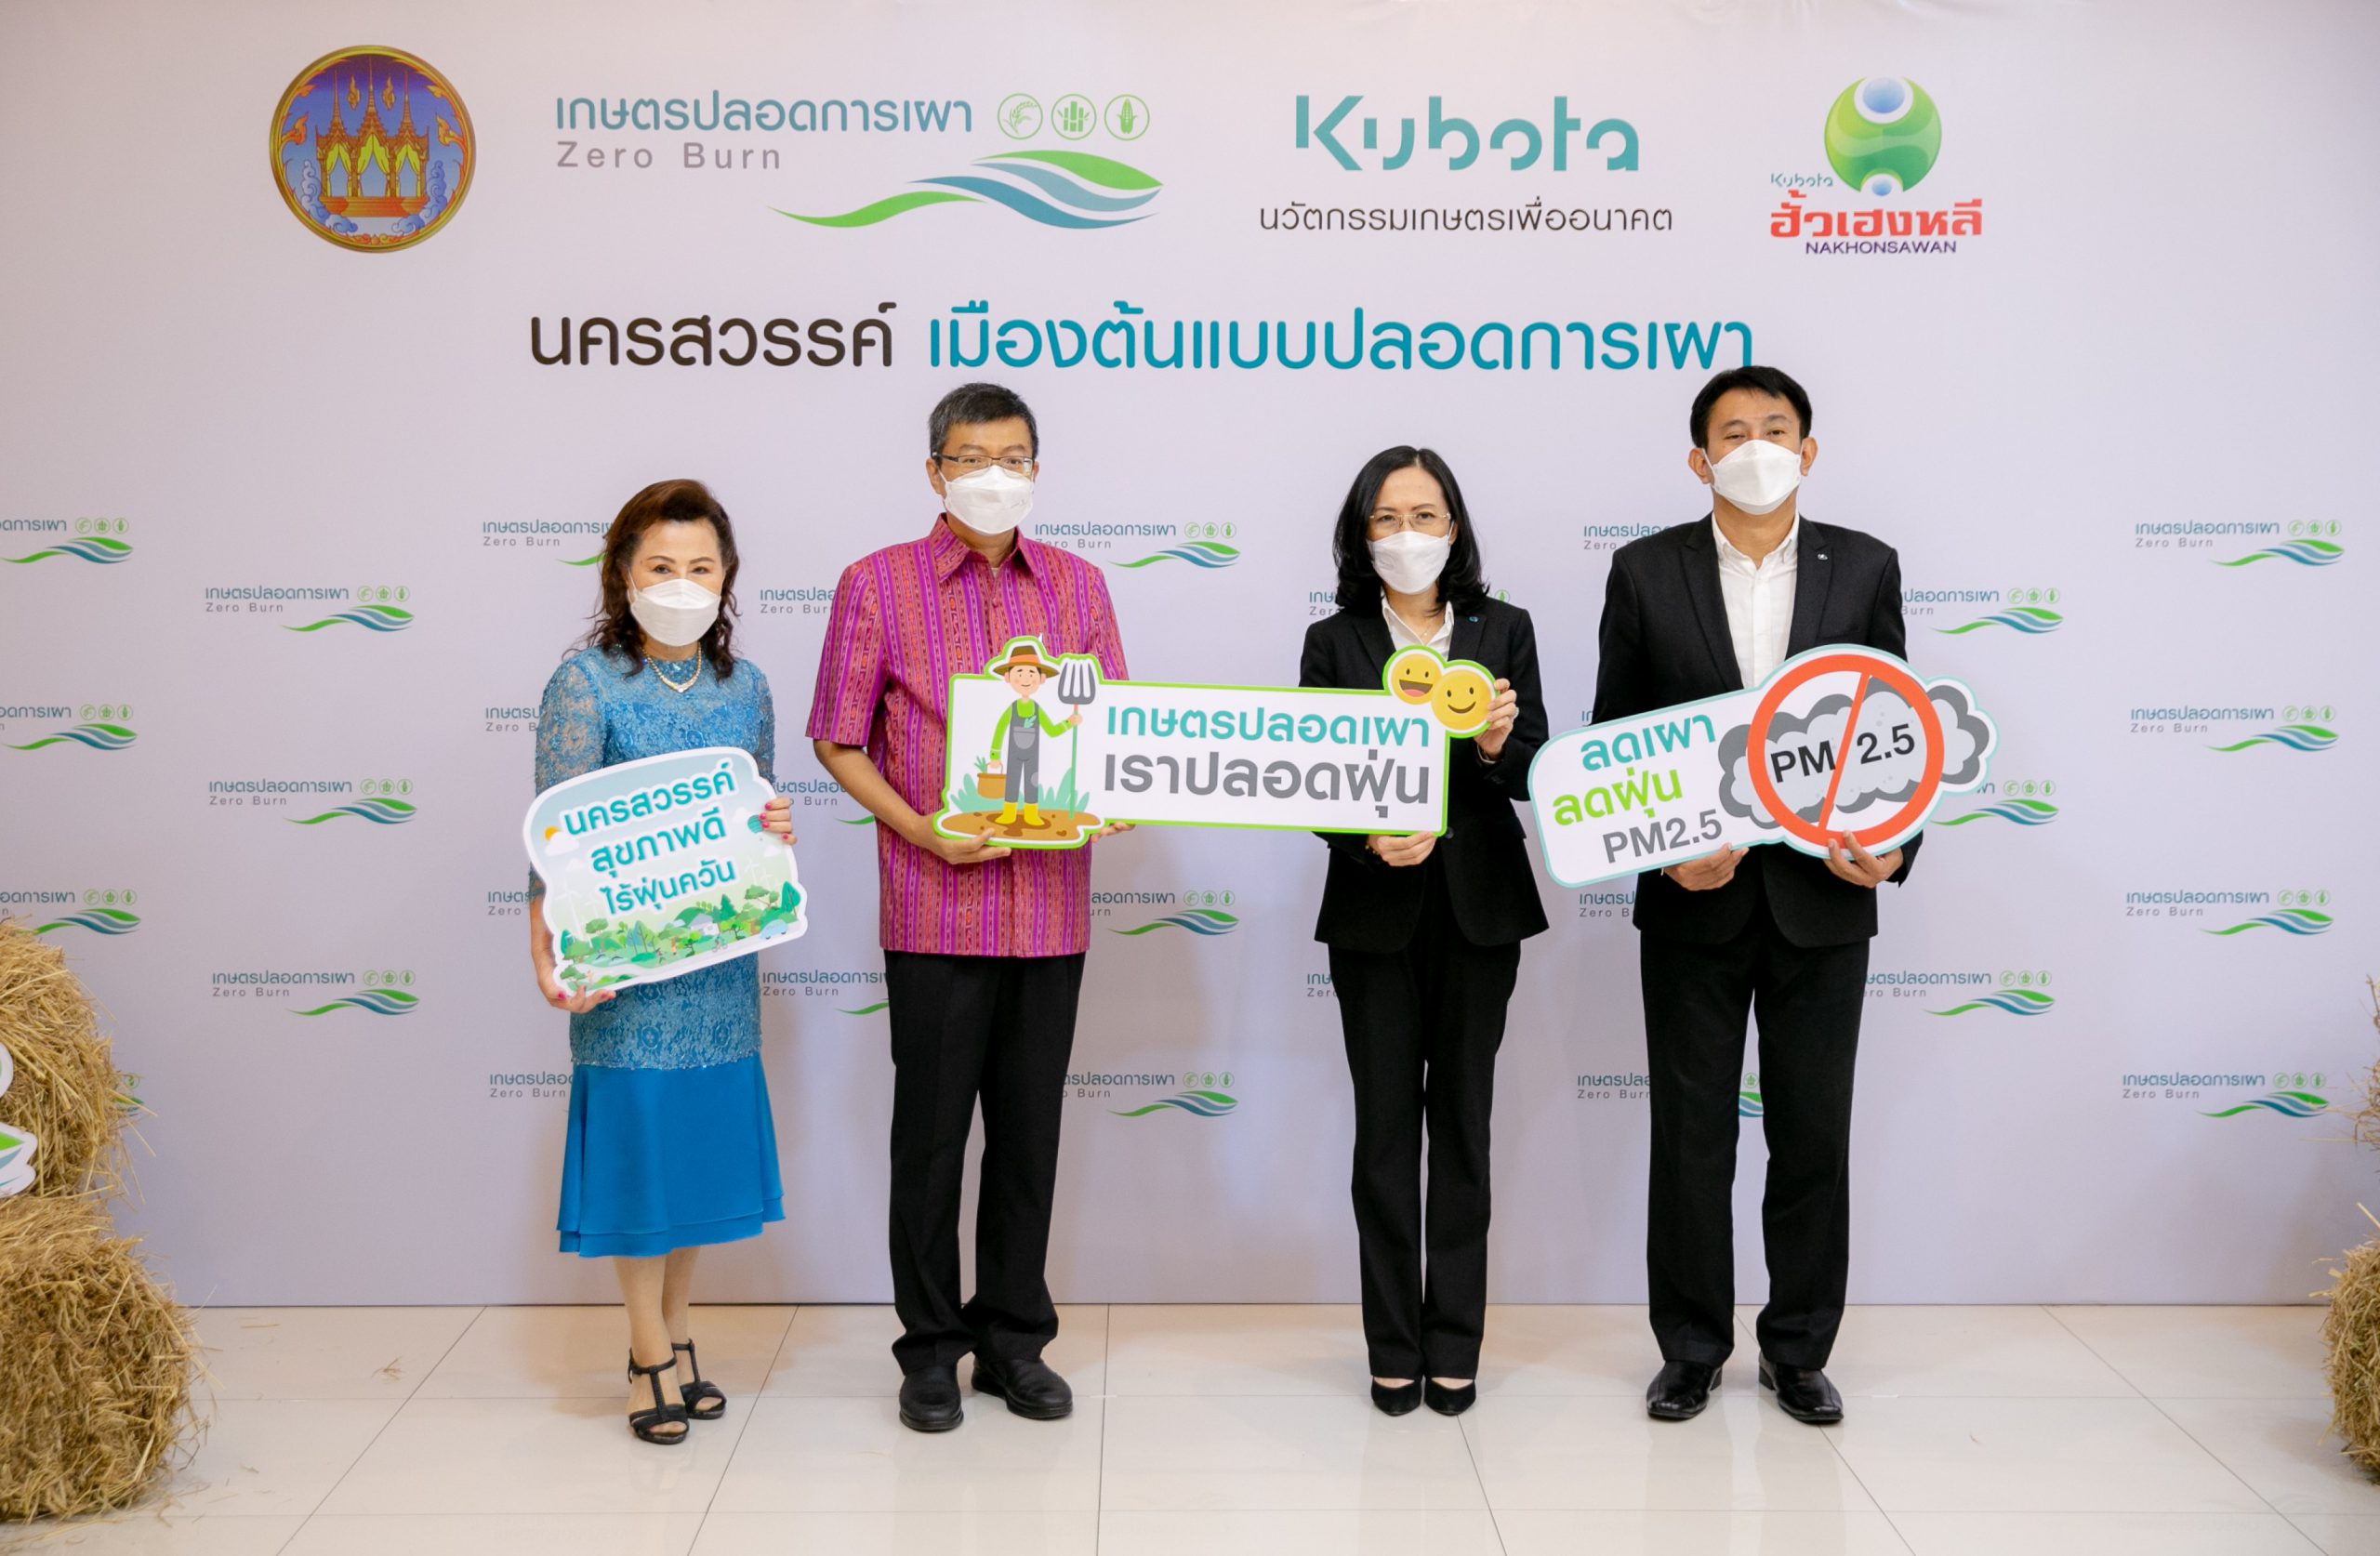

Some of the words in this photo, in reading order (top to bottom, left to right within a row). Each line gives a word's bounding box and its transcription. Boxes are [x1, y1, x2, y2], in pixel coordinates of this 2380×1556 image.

[557, 89, 972, 132] เกษตรปลอดการเผา
[557, 141, 654, 169] Zero
[684, 141, 780, 169] Burn
[1260, 198, 1673, 232] นวัตกรรมเกษตรเพื่ออนาคต
[1770, 189, 1982, 238] ฮั้วเฮงหลี
[1805, 241, 1957, 255] NAKHONSAWAN
[531, 301, 898, 367] นครสวรรค์
[931, 298, 1753, 370] เมืองต้นแบบปลอดการเผา
[483, 520, 613, 534] เกษตรปลอดการเ
[1035, 521, 1177, 535] เกษตรปลอดการเผา
[2135, 521, 2281, 534] เกษตรปลอดการเผา
[483, 536, 517, 547] Zero
[526, 536, 560, 547] Burn
[1078, 539, 1111, 548] Burn
[1584, 540, 1617, 550] Zero
[2135, 538, 2169, 548] Zero
[2179, 538, 2213, 548] Burn
[205, 586, 349, 600] เกษตรปลอดการเผา
[1904, 588, 2000, 602] ปลอดการเผา
[205, 602, 239, 613] Zero
[249, 602, 283, 613] Burn
[760, 604, 793, 614] Zero
[2130, 706, 2275, 720] เกษตรปลอดการเผา
[485, 722, 519, 732] Zero
[1107, 706, 1429, 747] เกษตรปลอดเผา
[2131, 723, 2164, 732] Zero
[2174, 723, 2207, 732] Burn
[1580, 714, 1716, 771] ลดเผา
[1770, 740, 1836, 783] PM
[1857, 723, 1916, 765] 2.5
[209, 779, 351, 793] เกษตรปลอดการเผา
[1104, 749, 1430, 818] เราปลอดฝุ่น
[210, 796, 244, 805] Zero
[253, 796, 286, 805] Burn
[564, 762, 735, 836] นครสวรรค์
[804, 797, 838, 806] Burn
[1553, 767, 1683, 825] ลดฝุ่น
[590, 807, 727, 877] สุขภาพดี
[1602, 809, 1723, 864] PM2.5
[600, 859, 736, 915] ไร้ฝุ่นควัน
[1091, 892, 1176, 904] ลอดการเผา
[2126, 890, 2270, 903] เกษตรปลอดการเผา
[488, 906, 522, 916] Zero
[1579, 908, 1612, 918] Zero
[2127, 906, 2161, 916] Zero
[2169, 906, 2203, 916] Burn
[212, 970, 355, 984] เกษตรปลอดการเผา
[762, 969, 887, 983] เกษตรปลอดการเ
[1866, 970, 1991, 984] ษตรปลอดการเผา
[213, 987, 246, 997] Zero
[256, 987, 289, 997] Burn
[762, 987, 796, 996] Zero
[805, 987, 839, 996] Burn
[1893, 988, 1926, 997] Burn
[2122, 1073, 2266, 1087] เกษตรปลอดการเผา
[490, 1088, 523, 1099] Zero
[533, 1088, 566, 1099] Burn
[1078, 1088, 1111, 1099] Burn
[1578, 1089, 1611, 1099] Zero
[2122, 1089, 2156, 1099] Zero
[2166, 1089, 2200, 1099] Burn
